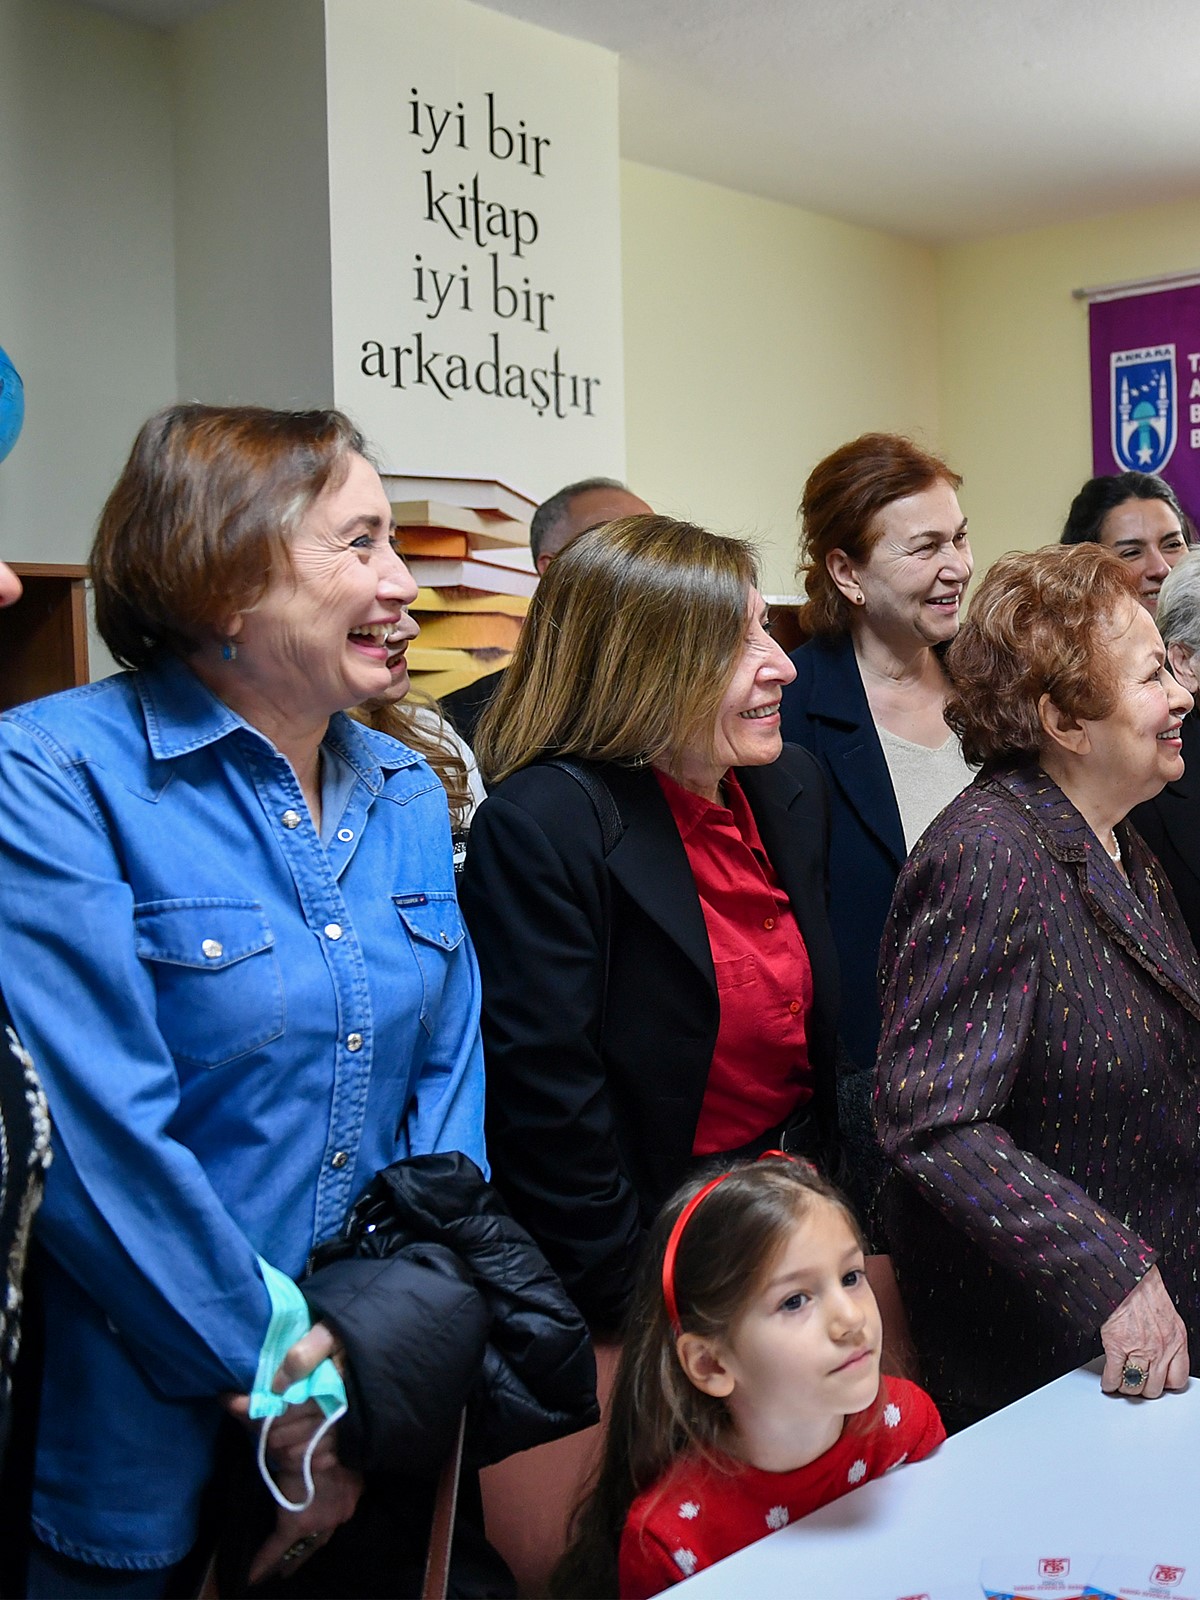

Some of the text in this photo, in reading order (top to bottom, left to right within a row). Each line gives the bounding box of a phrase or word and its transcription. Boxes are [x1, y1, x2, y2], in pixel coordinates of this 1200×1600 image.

[408, 87, 551, 177] iyi bir
[422, 169, 540, 258] kitap
[412, 252, 555, 333] iyi bir
[360, 332, 601, 419] arkadaştır
[1116, 348, 1171, 363] ANKARA
